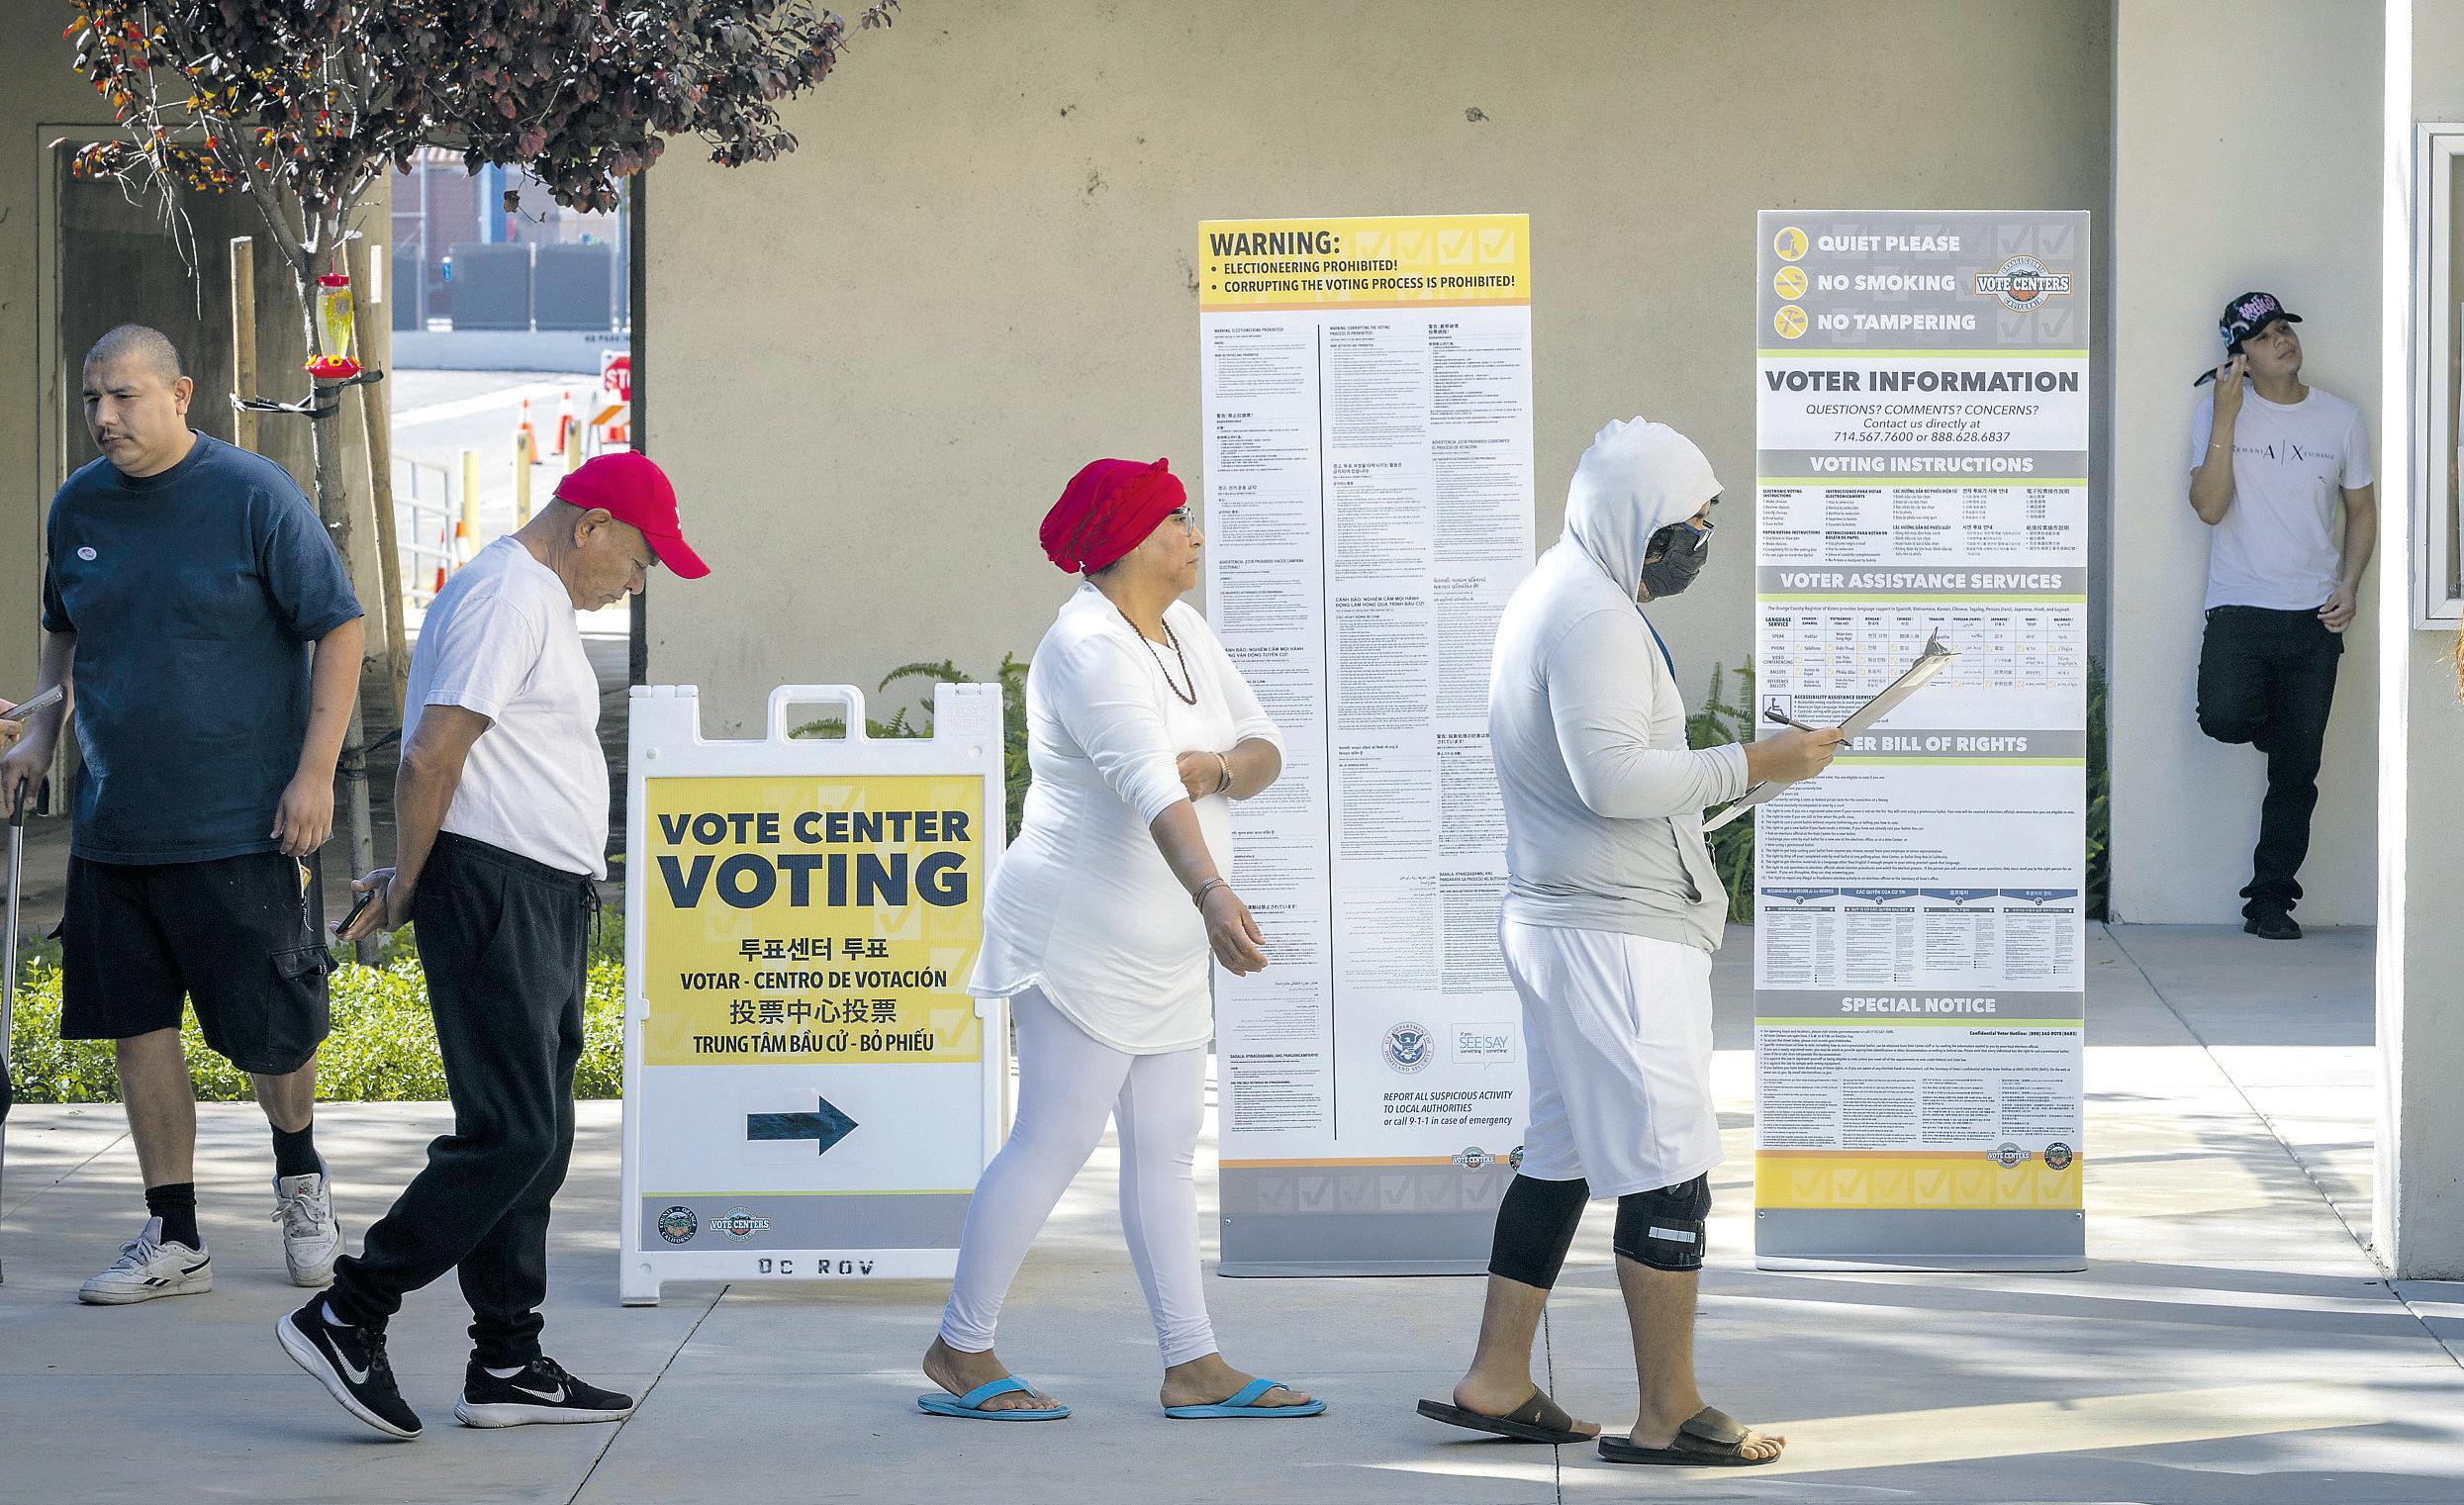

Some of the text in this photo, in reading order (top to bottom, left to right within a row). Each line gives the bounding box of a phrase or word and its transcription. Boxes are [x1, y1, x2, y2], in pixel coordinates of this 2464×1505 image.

[1209, 231, 1340, 256] WARNING:
[1818, 236, 1959, 251] QUIET PLEASE
[1224, 260, 1398, 275] ELECTIONEERING PROHIBITED!
[1224, 275, 1515, 293] CORRUPTING THE VOTING PROCESS IS PROHIBITED!
[1818, 275, 1955, 291] NO SMOKING
[1977, 276, 2069, 291] VOTE CENTERS
[2004, 297, 2042, 310] CALIFORNIA
[1818, 315, 1975, 329] NO TAMPERING
[1765, 370, 2078, 392] VOTER INFORMATION
[1806, 405, 2038, 416] QUESTIONS? COMMENTS? CONCERNS?
[1863, 419, 1908, 429] Contact
[1926, 418, 1965, 430] directly
[1970, 420, 1980, 428] at
[1834, 432, 1913, 443] 714.567.7600
[1932, 431, 2010, 442] 888.628.6837
[1810, 457, 2033, 473] VOTING INSTRUCTIONS
[1780, 573, 2062, 589] VOTER ASSISTANCE SERVICES
[1882, 736, 1921, 751] BILL
[1925, 736, 1951, 751] OF
[1956, 737, 2028, 752] RIGHTS
[658, 810, 972, 845] VOTE CENTER
[657, 851, 968, 908] VOTING
[738, 938, 889, 962] 투표센터 투표
[681, 972, 740, 990] VOTAR
[754, 972, 823, 989] CENTRO
[828, 972, 851, 988] DE
[855, 966, 947, 988] VOTACIÓN
[729, 998, 897, 1025] 投票中心投票
[1841, 997, 1995, 1013] SPECIAL NOTICE
[694, 1035, 748, 1053] TRUNG
[751, 1031, 786, 1053] TÂM
[790, 1030, 823, 1052] BẦU
[826, 1028, 848, 1052] CỬ
[860, 1028, 883, 1051] BỎ
[886, 1027, 933, 1051] PHIẾU
[1460, 1036, 1508, 1049] SEE SAY
[1383, 1092, 1414, 1101] REPORT
[1431, 1091, 1477, 1100] SUSPICIOUS
[1479, 1090, 1513, 1099] ACTIVITY
[1396, 1104, 1419, 1113] LOCAL
[1469, 1117, 1512, 1126] emergency
[659, 1208, 674, 1228] COUNTY
[711, 1220, 769, 1229] VOTE CENTERS
[662, 1232, 695, 1244] CALIFORNIA
[818, 1259, 874, 1275] ROV
